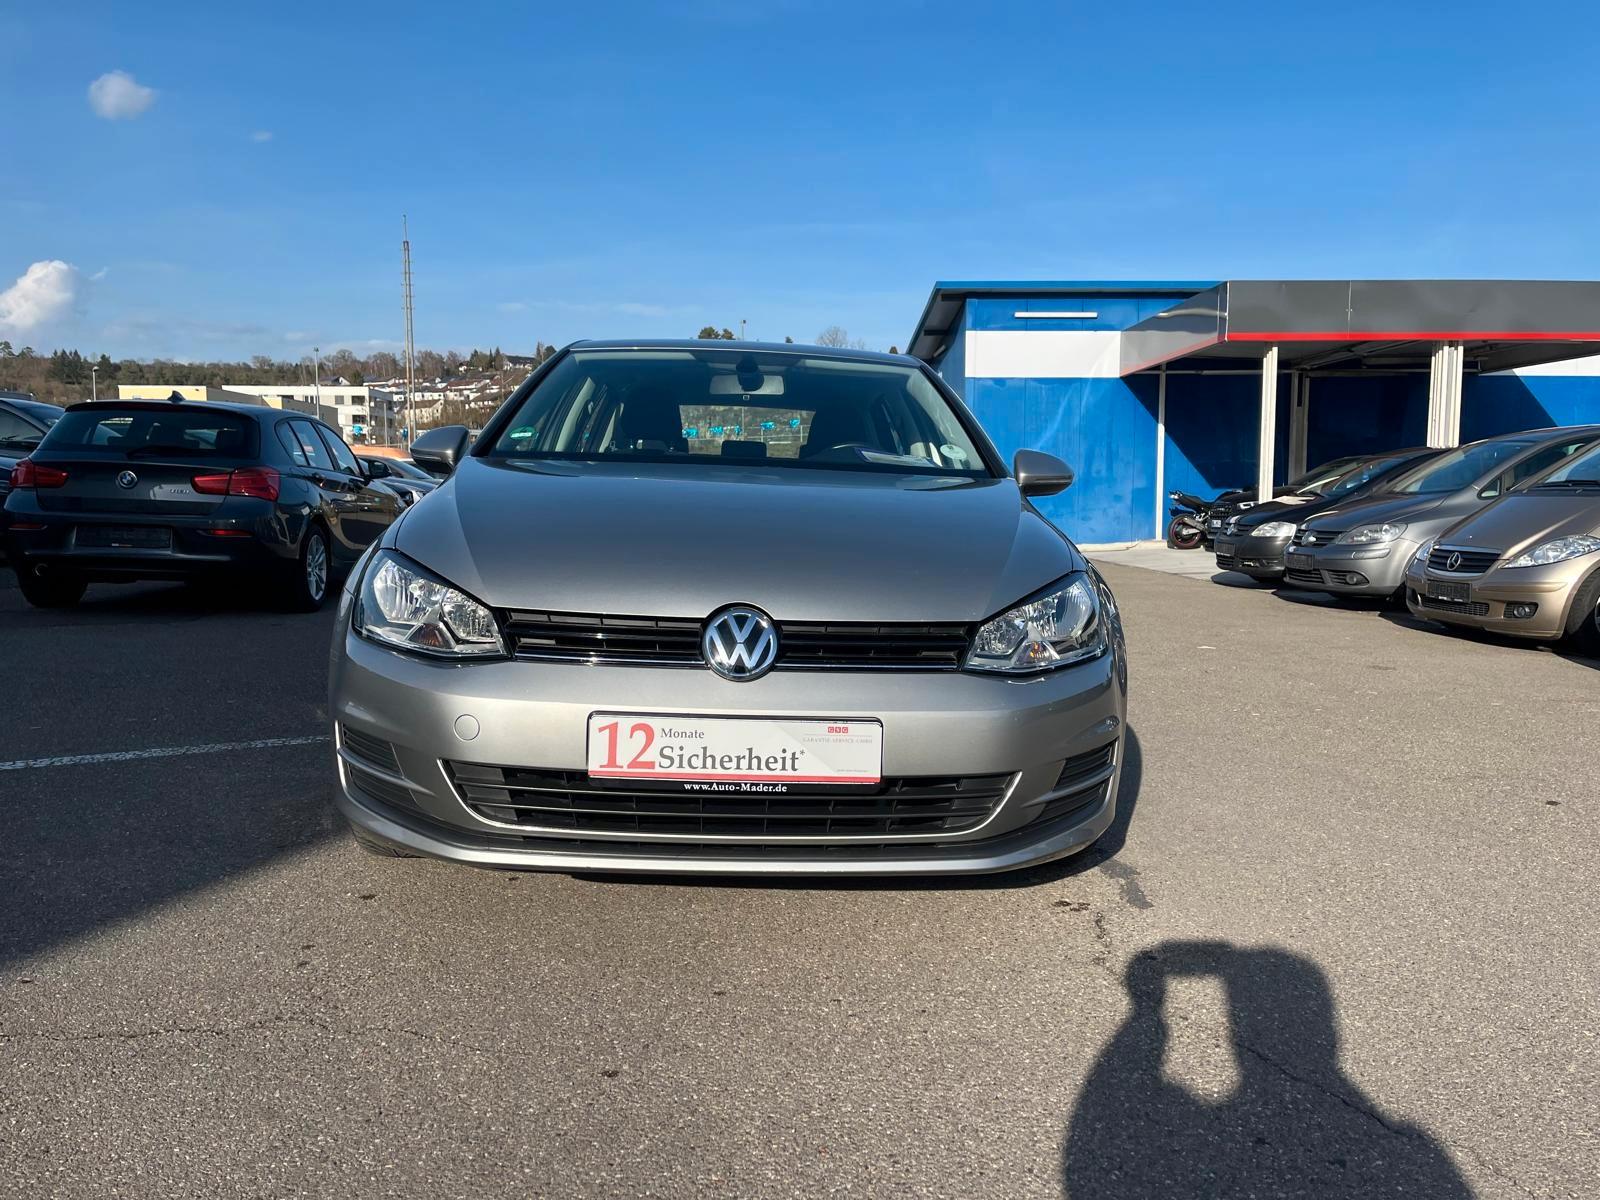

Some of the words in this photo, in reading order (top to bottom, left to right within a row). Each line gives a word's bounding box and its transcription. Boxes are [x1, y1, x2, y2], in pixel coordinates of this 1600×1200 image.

[706, 606, 778, 678] VW
[598, 721, 656, 769] 12
[660, 727, 705, 739] Monate
[683, 782, 788, 792] www.Auto-Mader.de
